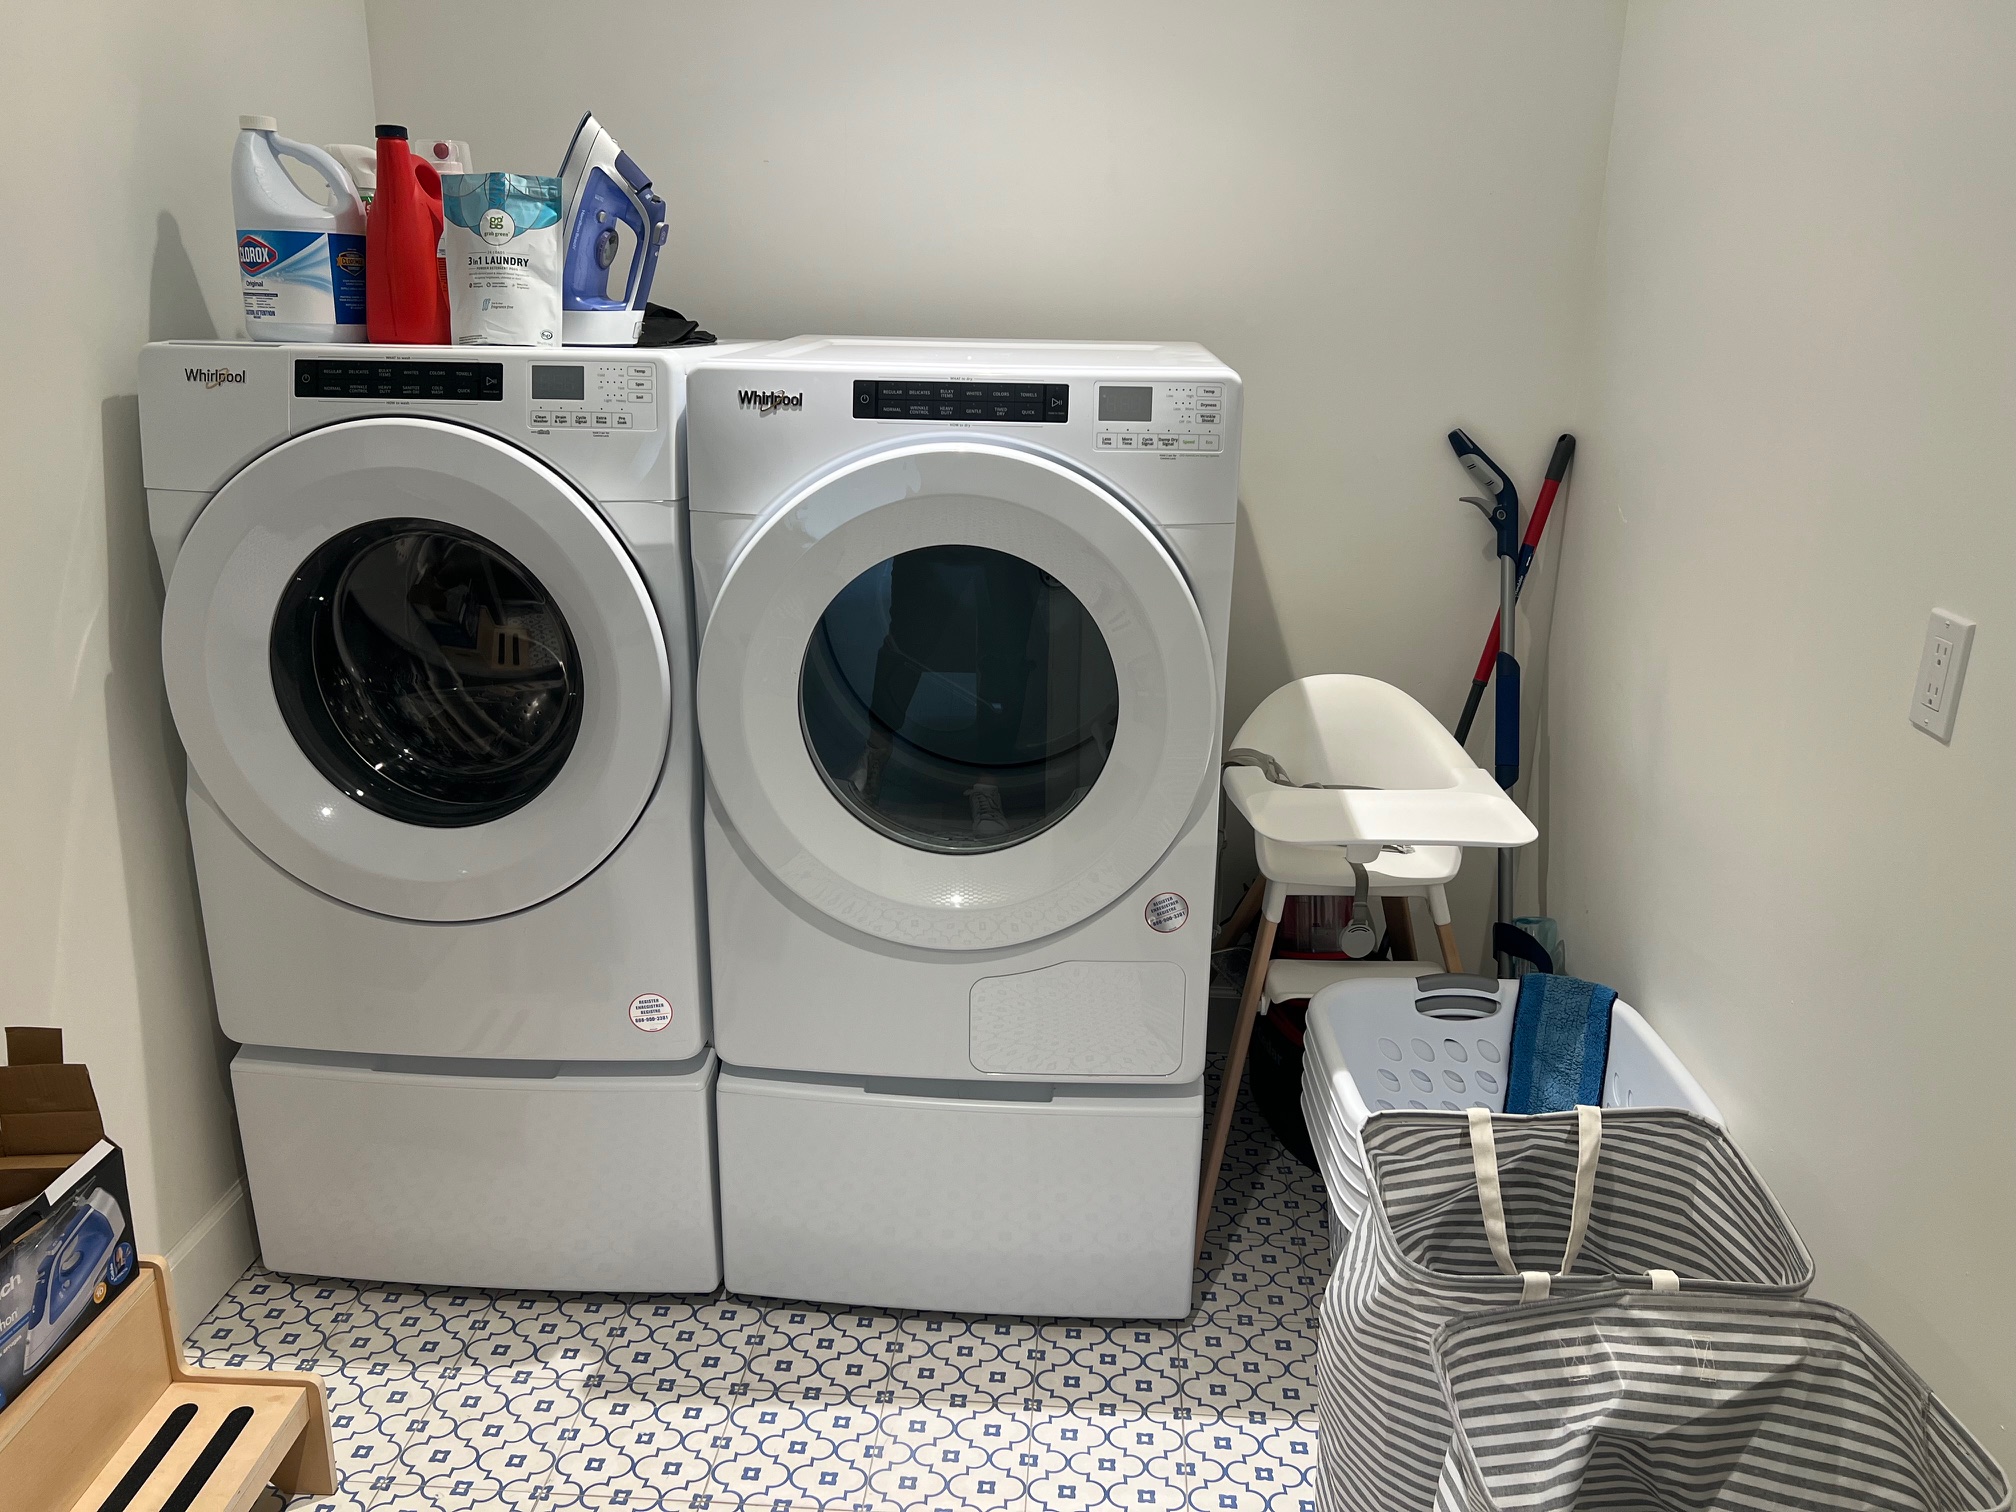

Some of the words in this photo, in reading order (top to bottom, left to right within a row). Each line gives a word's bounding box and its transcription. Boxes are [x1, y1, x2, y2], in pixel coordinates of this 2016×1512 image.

[495, 230, 509, 238] green
[239, 247, 269, 263] CLOROX
[485, 256, 530, 268] LAUNDRY
[246, 280, 264, 288] Original
[184, 367, 247, 387] Whirlpool
[738, 390, 803, 410] Whirlpool
[1151, 900, 1178, 913] ENREGISTRER
[1153, 897, 1173, 907] REGISTER
